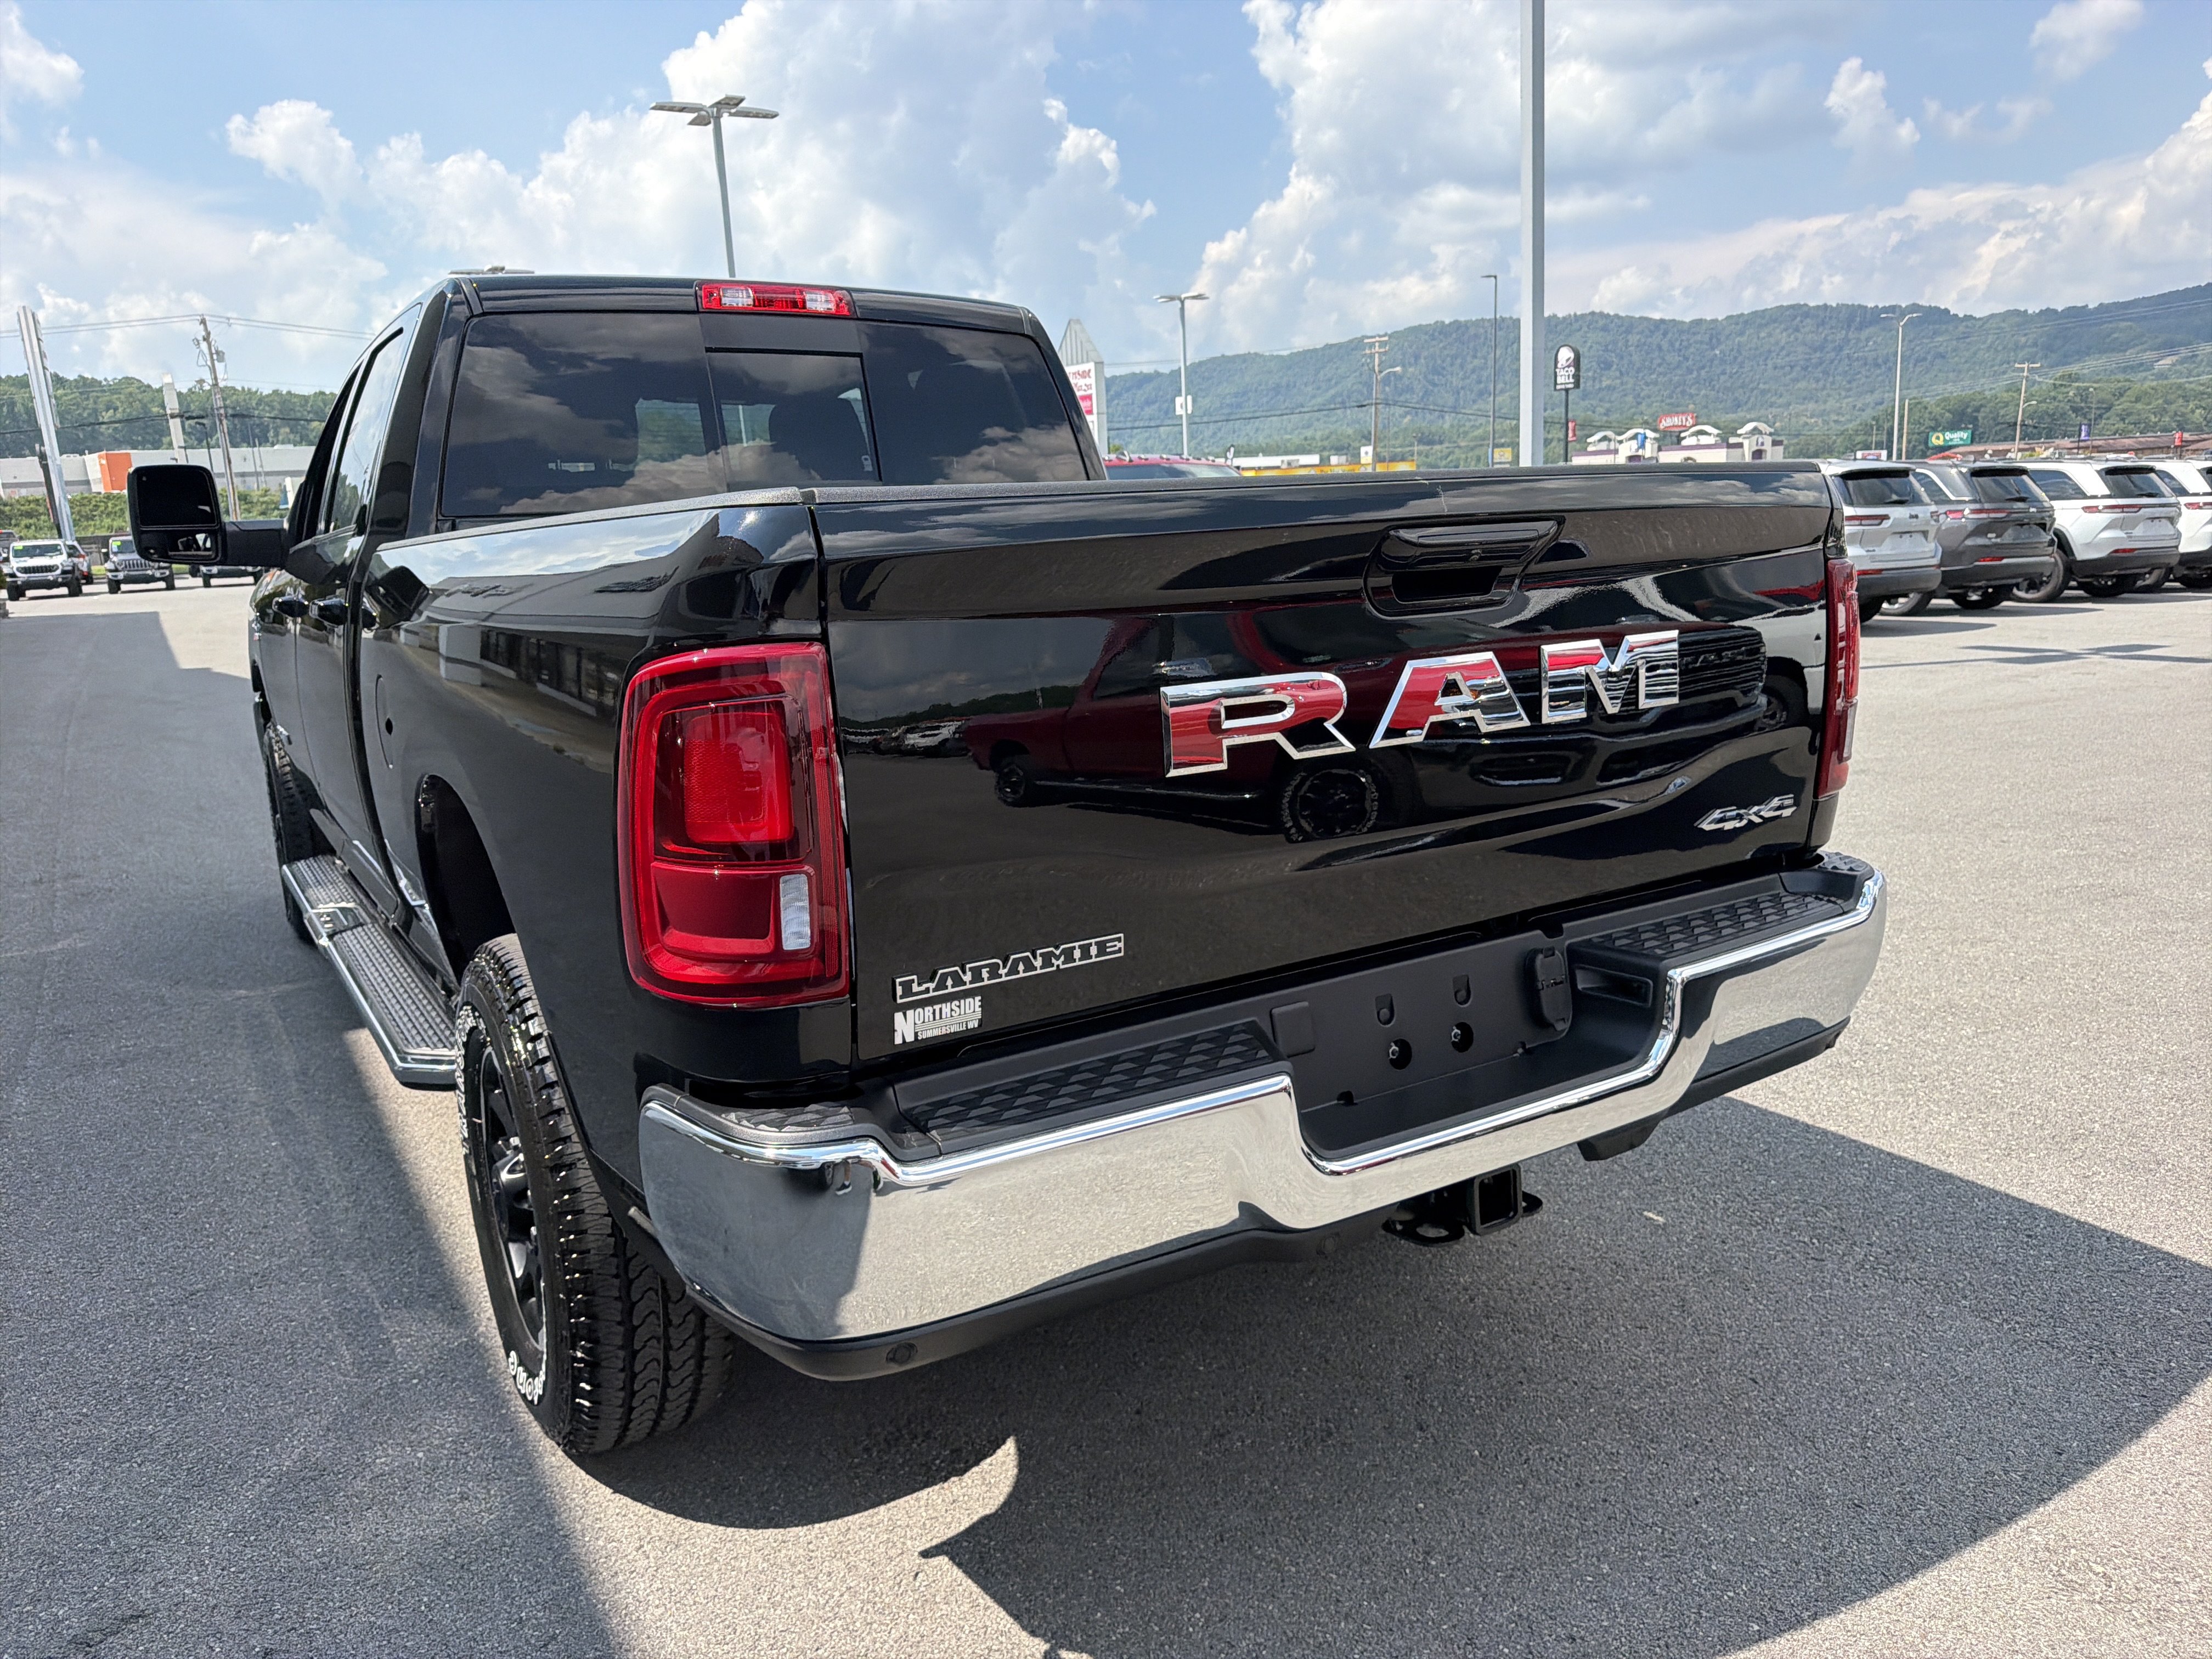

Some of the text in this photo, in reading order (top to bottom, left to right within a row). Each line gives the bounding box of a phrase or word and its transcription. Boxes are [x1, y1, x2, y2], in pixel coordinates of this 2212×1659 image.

[1555, 366, 1575, 376] TACO
[1556, 374, 1575, 384] BELL
[1944, 431, 1968, 440] Quality
[1160, 629, 1680, 777] RAM
[893, 933, 1124, 1003] LARAMIE
[894, 996, 981, 1045] NORTHSIDE
[917, 1019, 979, 1040] SUMMERSVILLE WV
